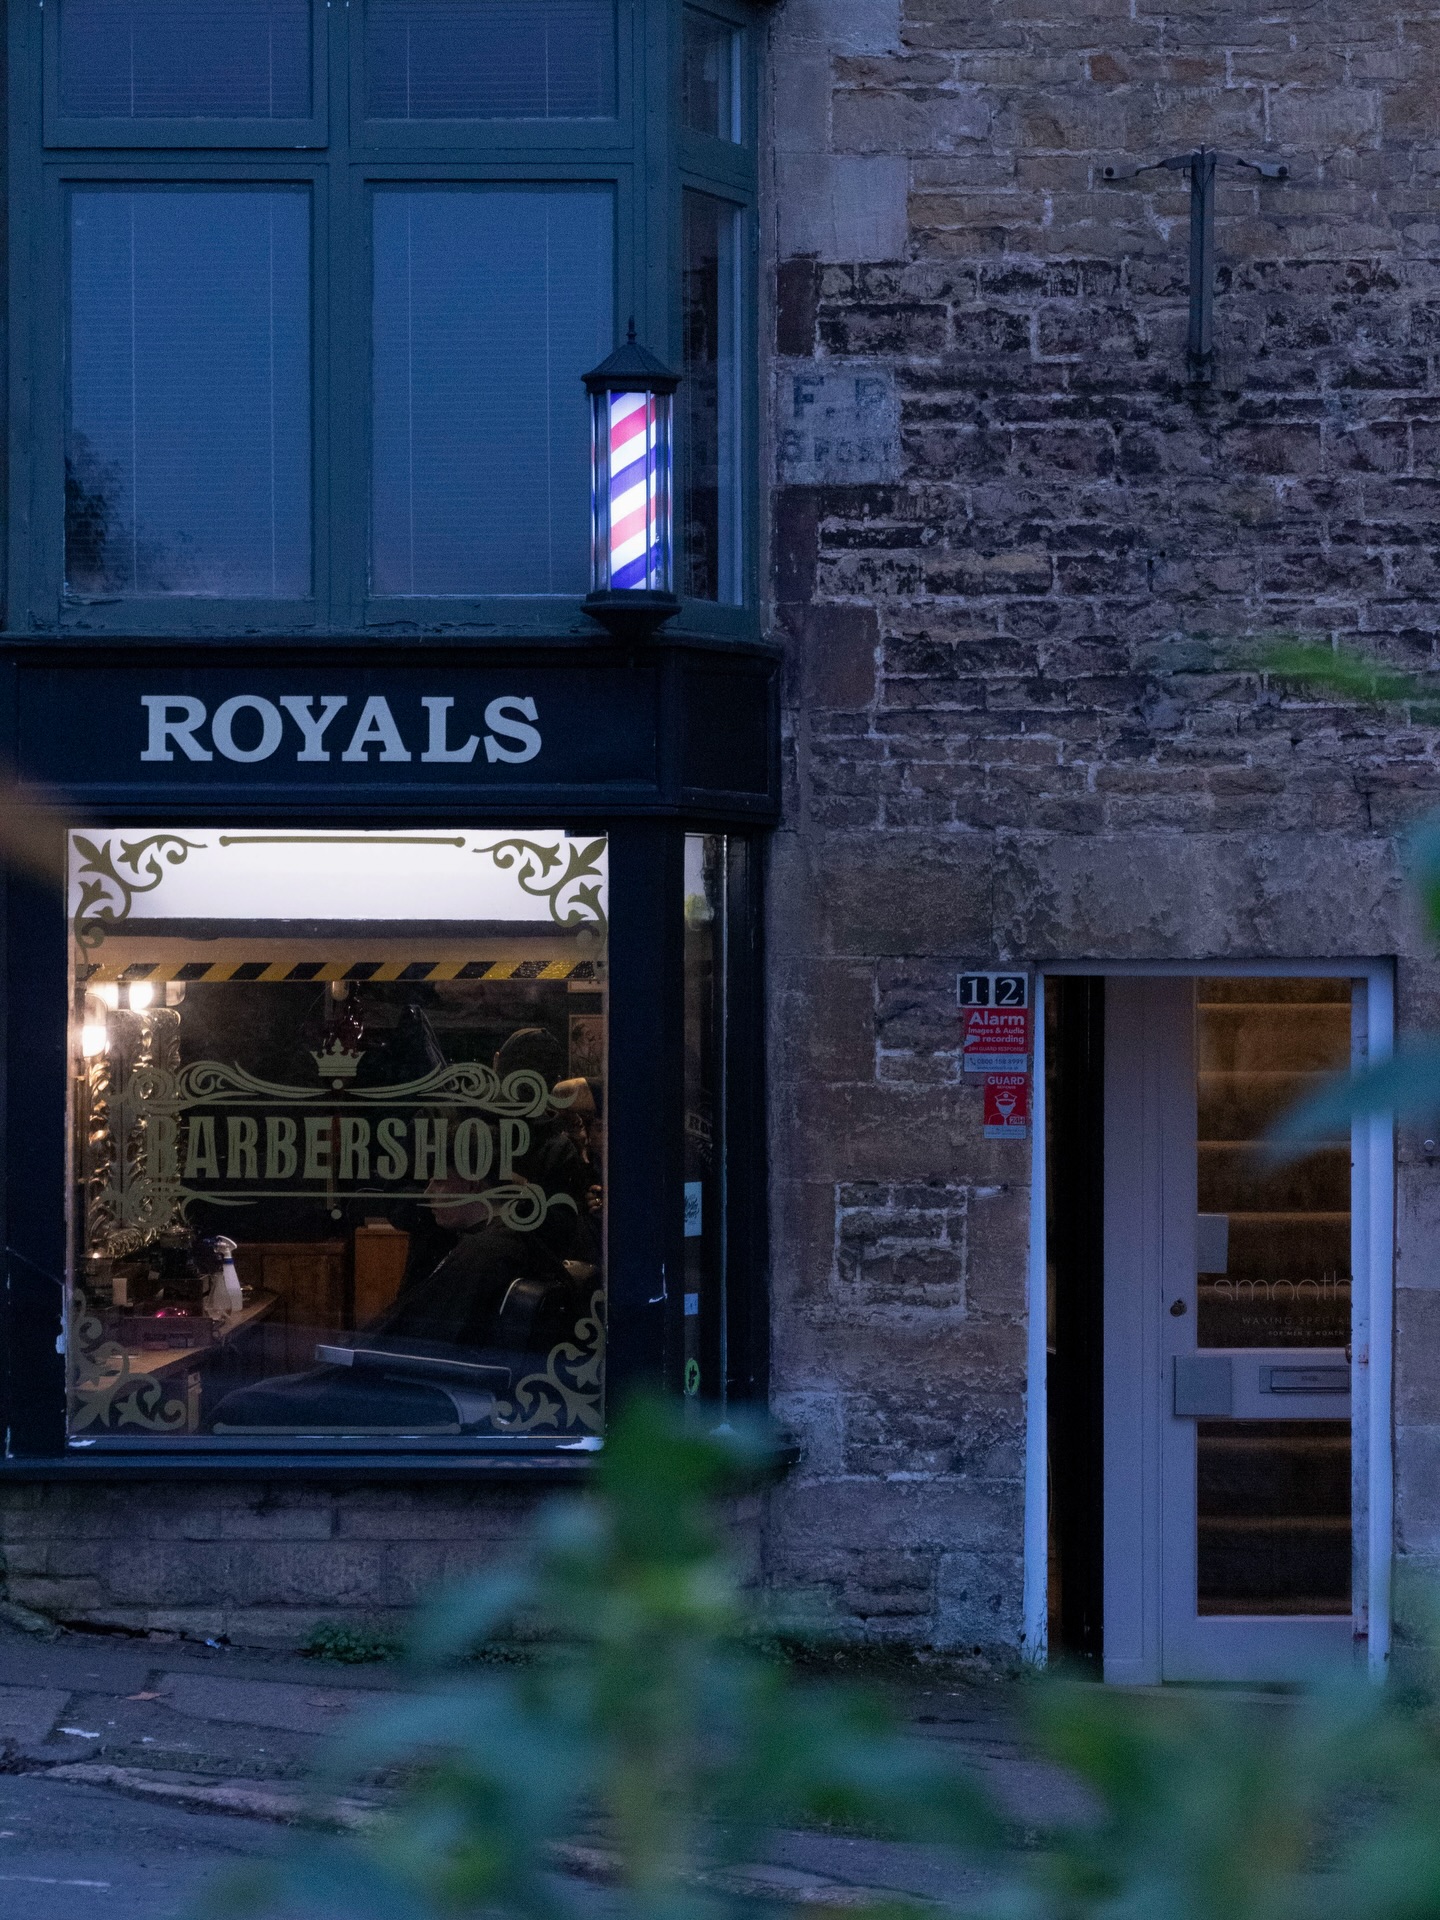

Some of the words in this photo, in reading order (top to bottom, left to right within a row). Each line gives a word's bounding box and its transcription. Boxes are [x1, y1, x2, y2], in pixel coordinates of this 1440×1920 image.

[140, 694, 542, 763] ROYALS
[967, 978, 1020, 1005] 12
[969, 1011, 1025, 1025] Alarm
[968, 1027, 993, 1036] Images
[982, 1034, 1025, 1045] recording
[987, 1076, 1025, 1085] GUARD
[145, 1115, 531, 1181] BARBERSHOP
[1214, 1271, 1351, 1301] smooth
[1242, 1316, 1293, 1325] WAXING
